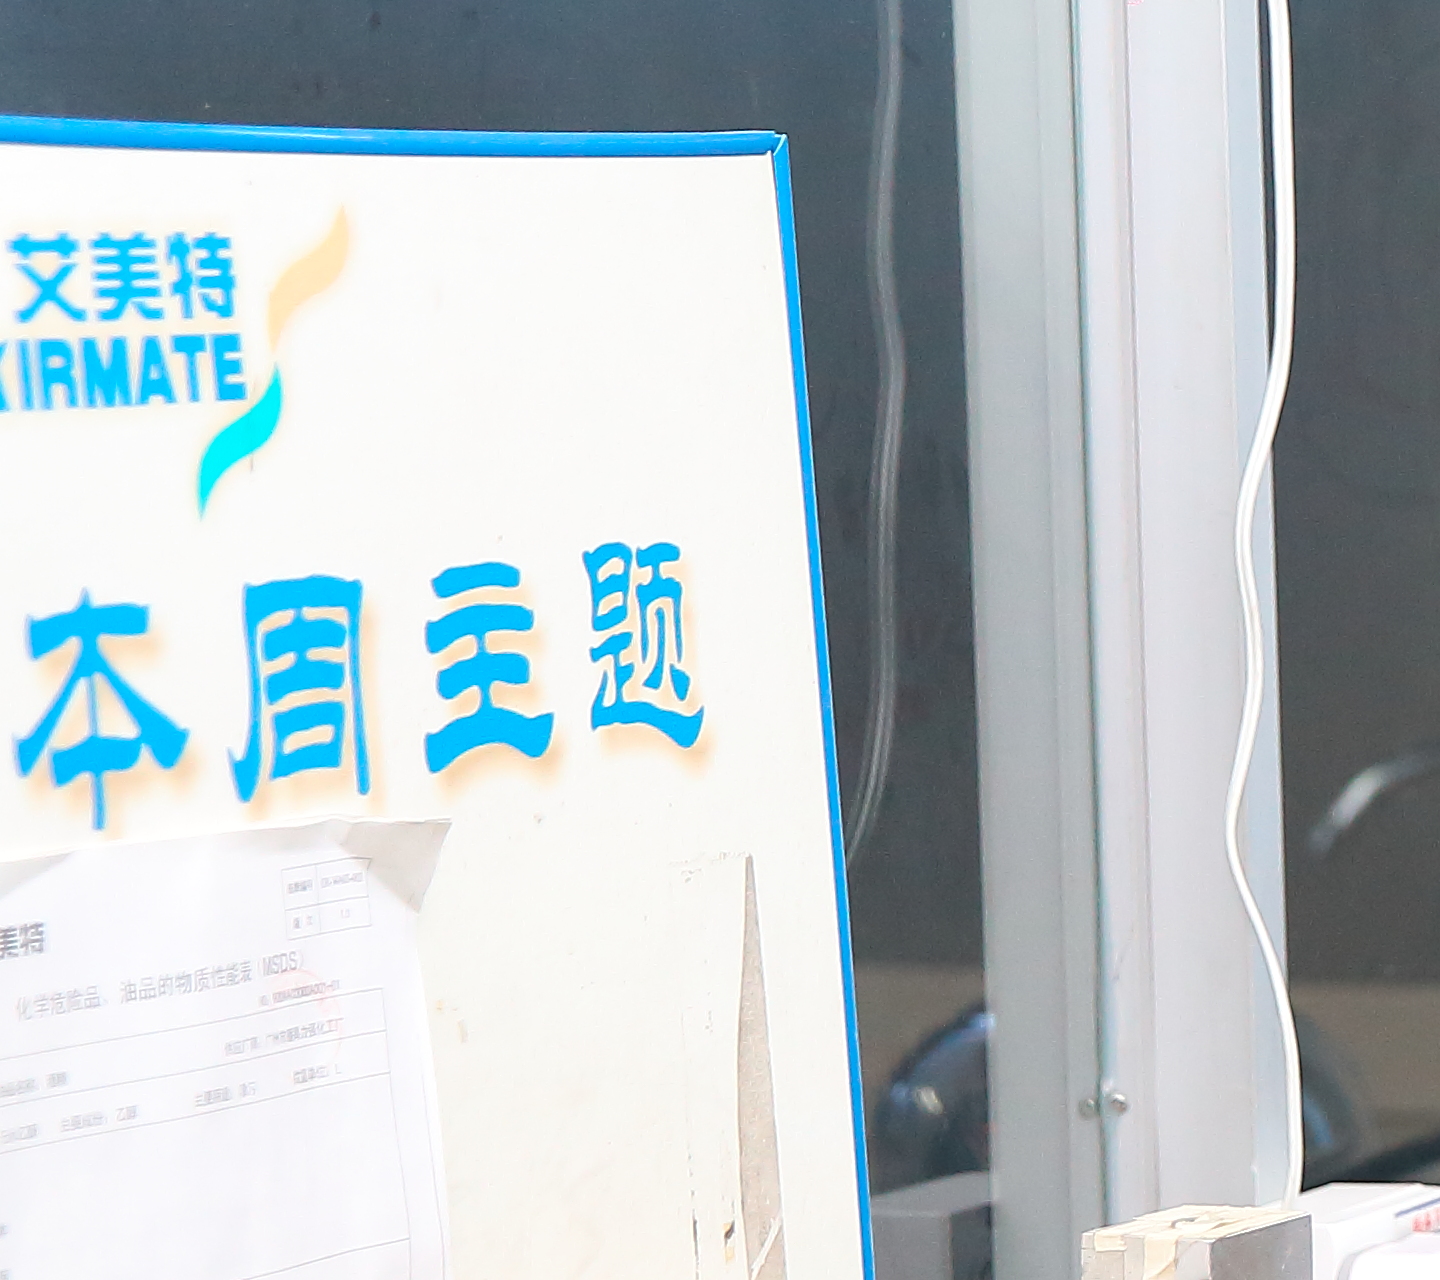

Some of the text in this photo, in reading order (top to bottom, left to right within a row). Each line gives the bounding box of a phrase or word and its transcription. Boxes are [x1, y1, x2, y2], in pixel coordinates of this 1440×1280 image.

[7, 231, 237, 322] 艾美特
[14, 541, 704, 832] 本周主题
